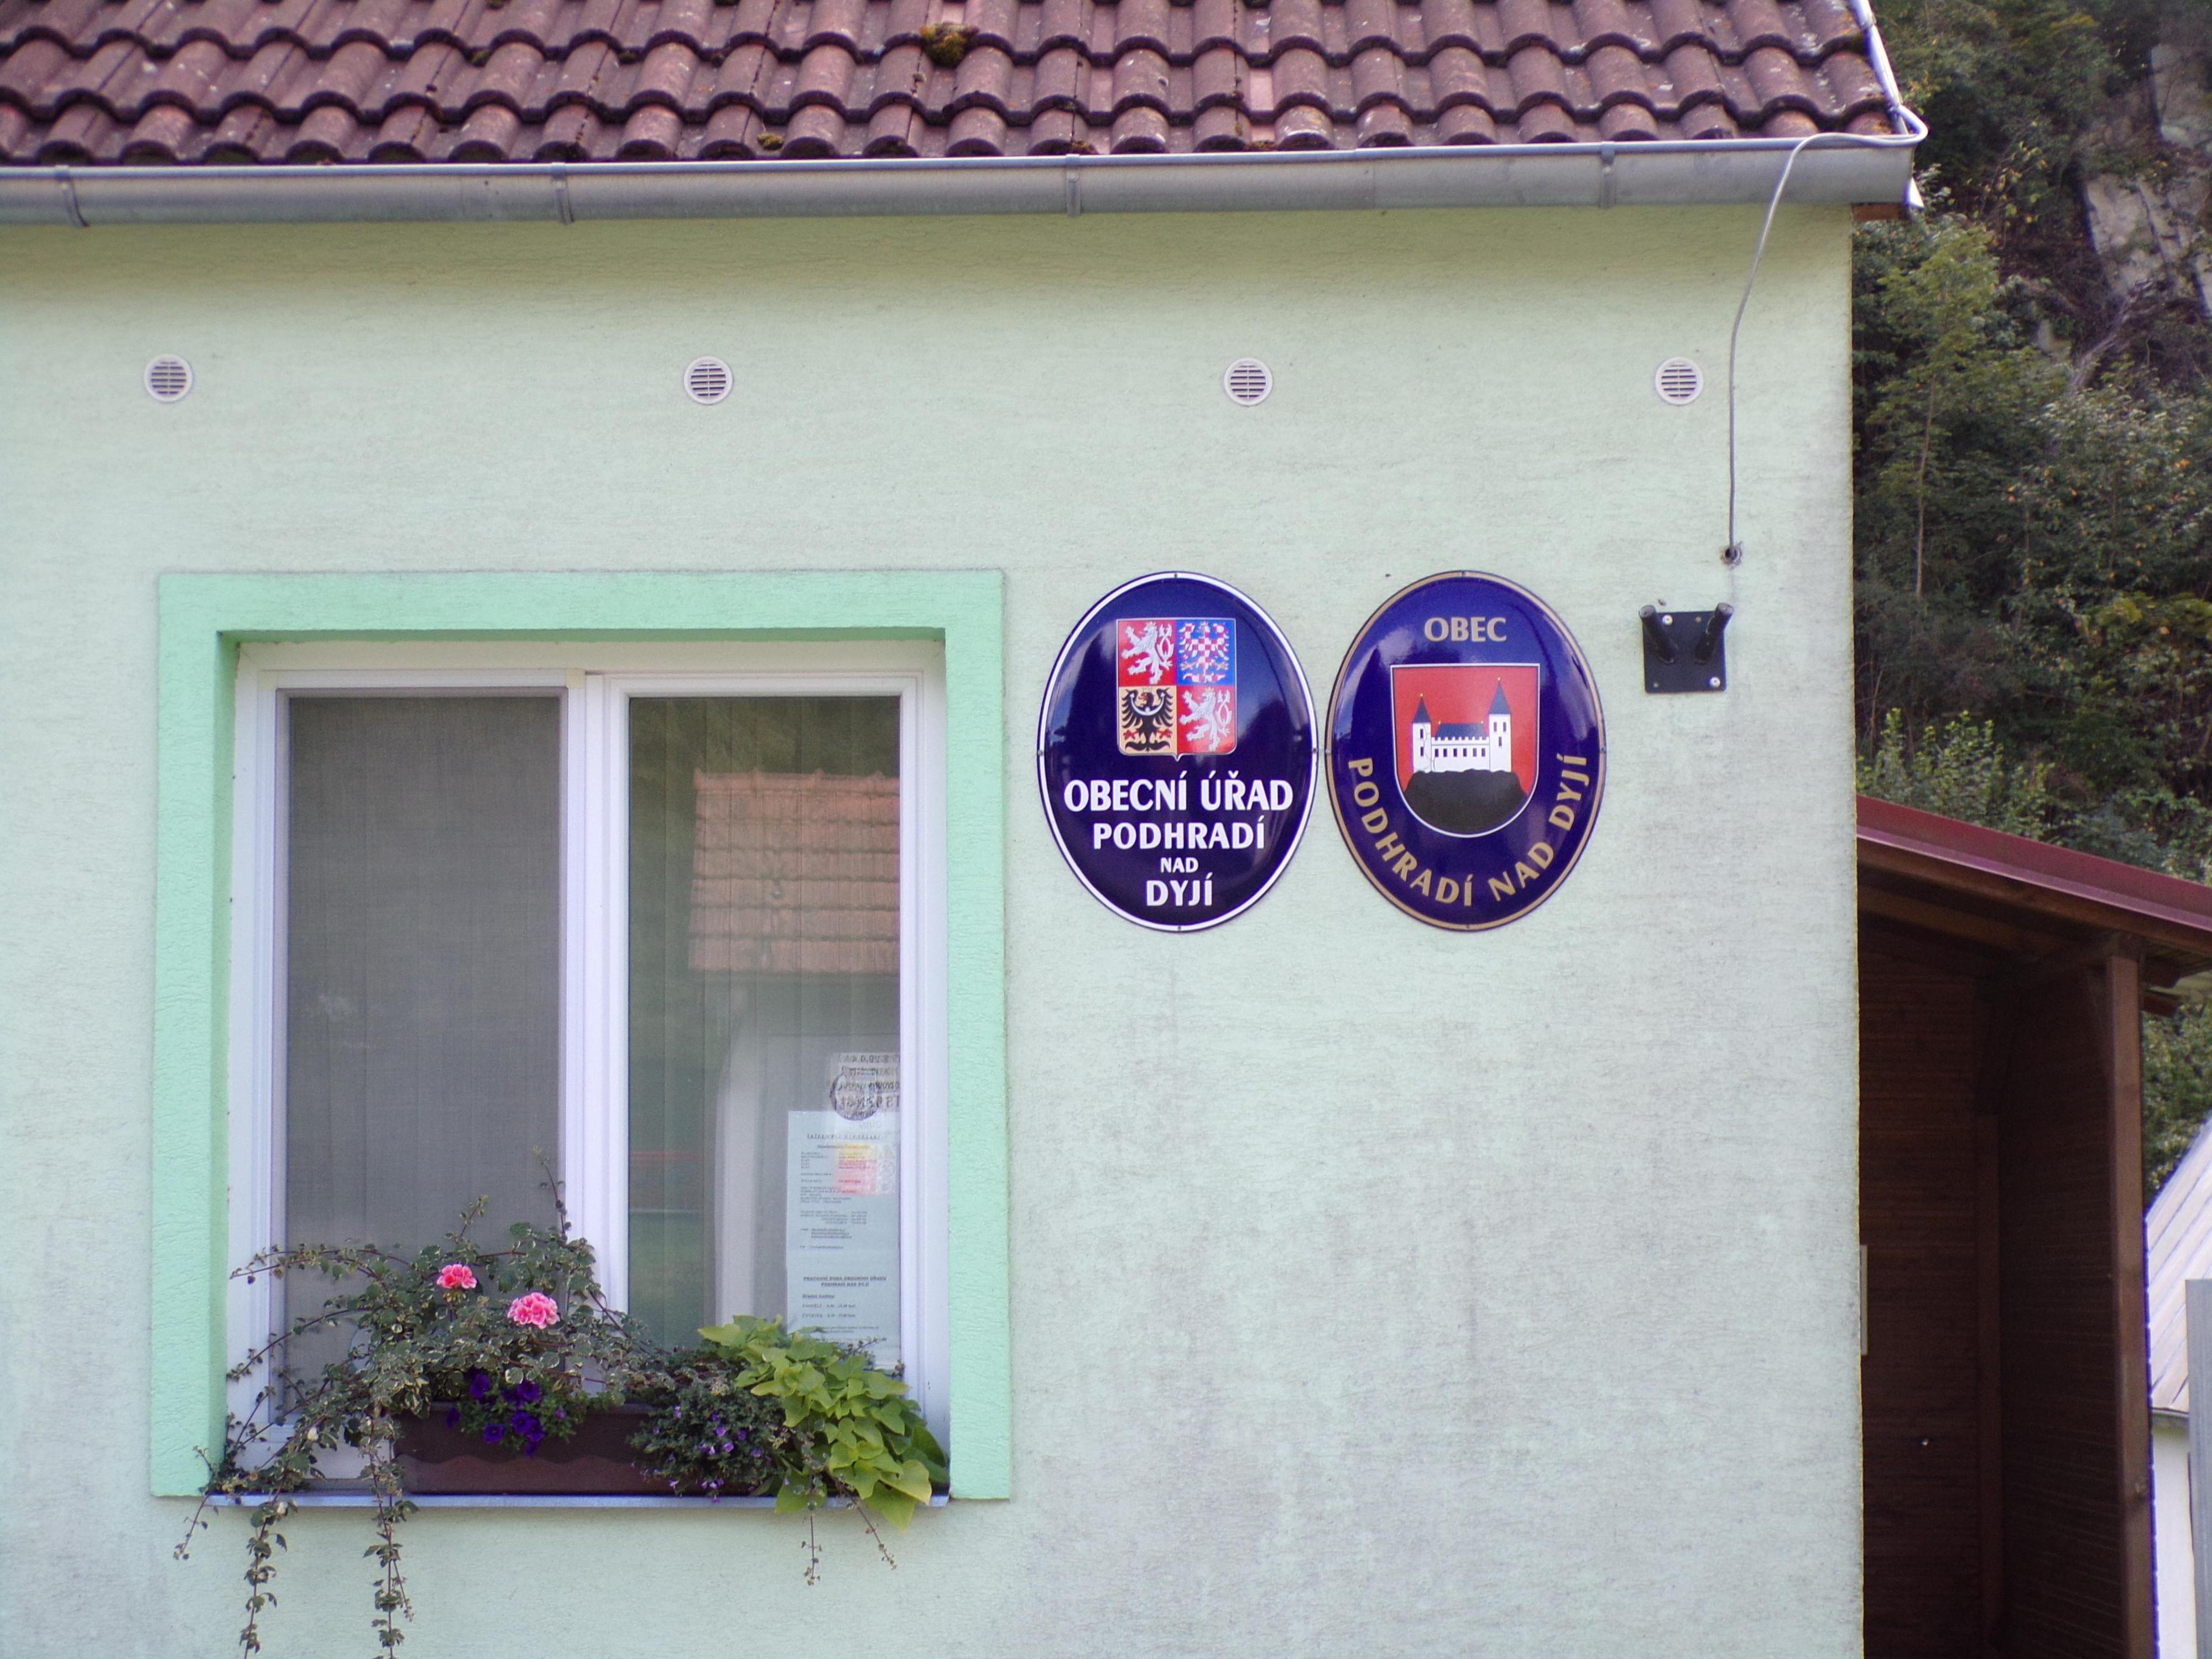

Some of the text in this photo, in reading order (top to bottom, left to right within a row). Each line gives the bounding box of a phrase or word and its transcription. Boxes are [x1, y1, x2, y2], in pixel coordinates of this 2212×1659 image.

[1424, 617, 1507, 643] OBEC
[1063, 770, 1293, 812] OBECNÍ ÚŘAD
[1093, 815, 1265, 850] PODHRADÍ
[1348, 753, 1590, 907] PODHRADÍ NAD DYJÍ
[1160, 857, 1199, 873] NAD
[1146, 872, 1213, 906] DYJÍ
